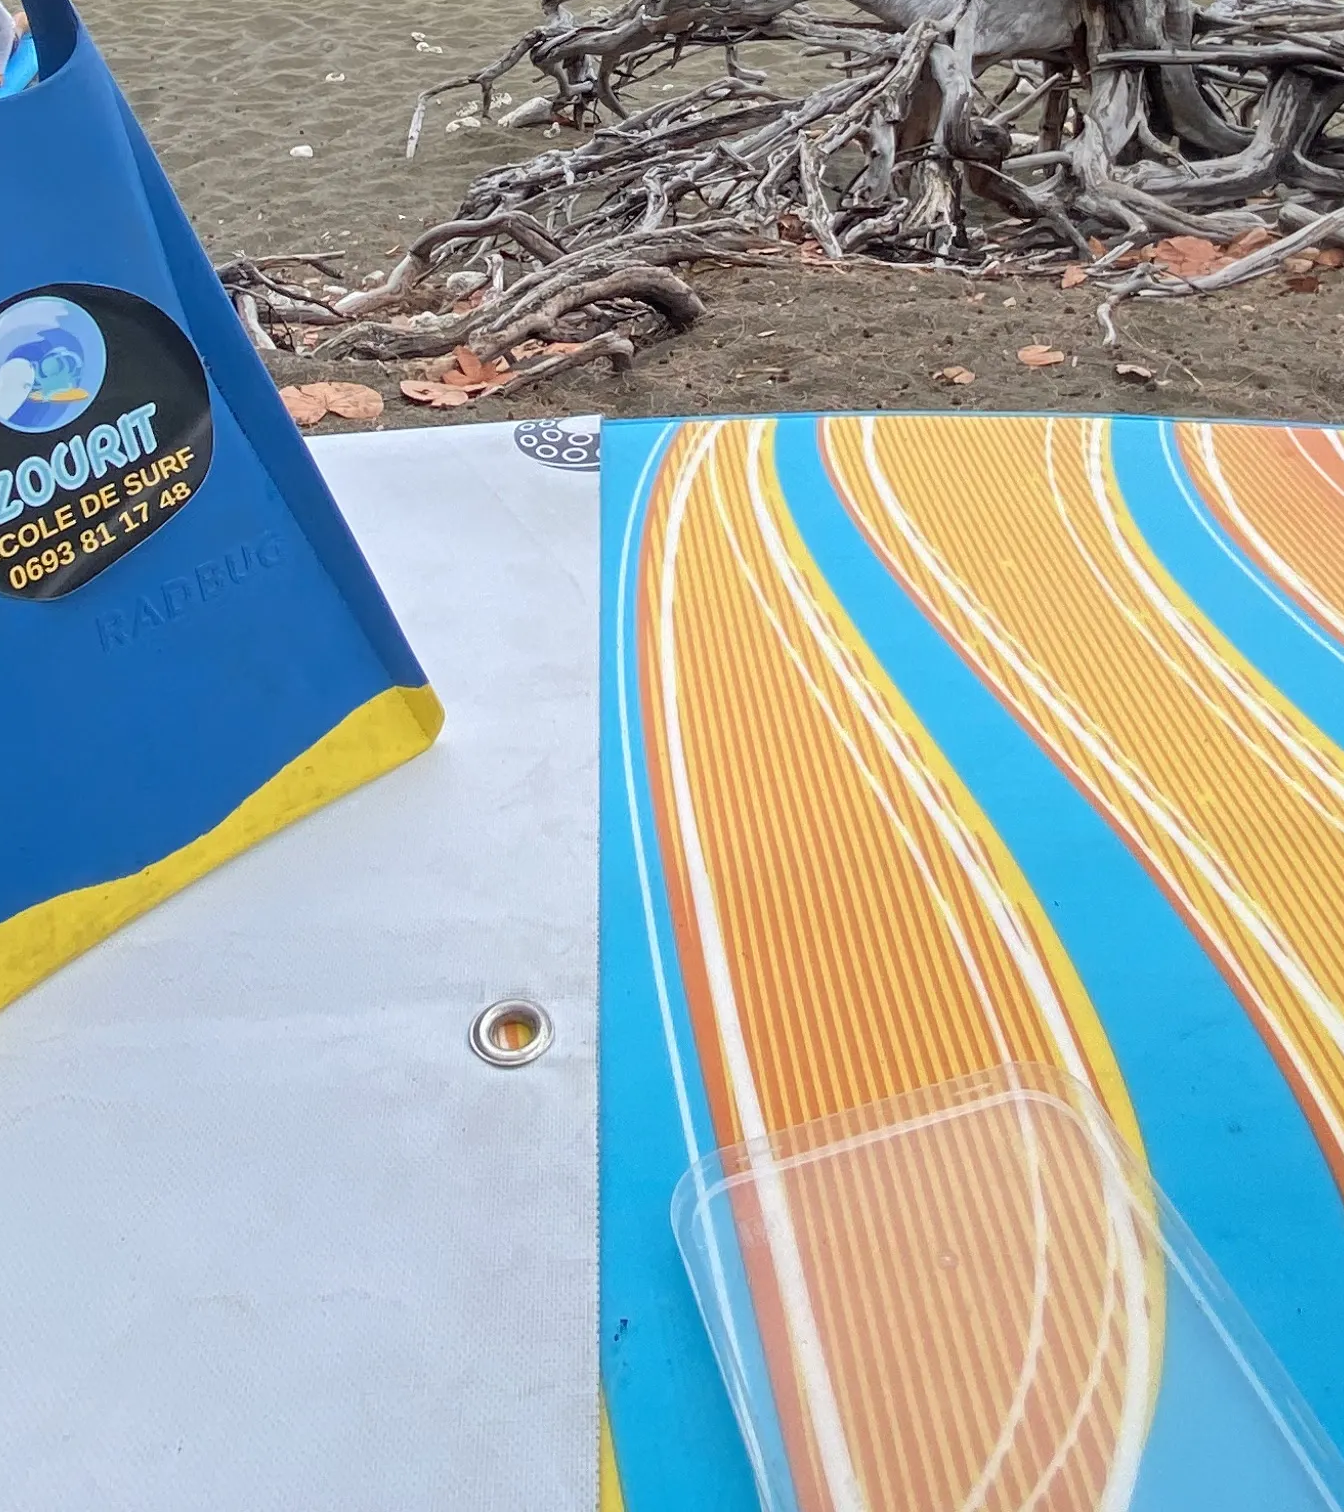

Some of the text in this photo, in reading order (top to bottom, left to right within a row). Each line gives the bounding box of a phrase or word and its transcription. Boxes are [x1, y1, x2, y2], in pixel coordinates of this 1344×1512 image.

[80, 483, 121, 519] DE
[123, 446, 195, 496] SURF
[9, 481, 192, 590] 0693 81 17 48
